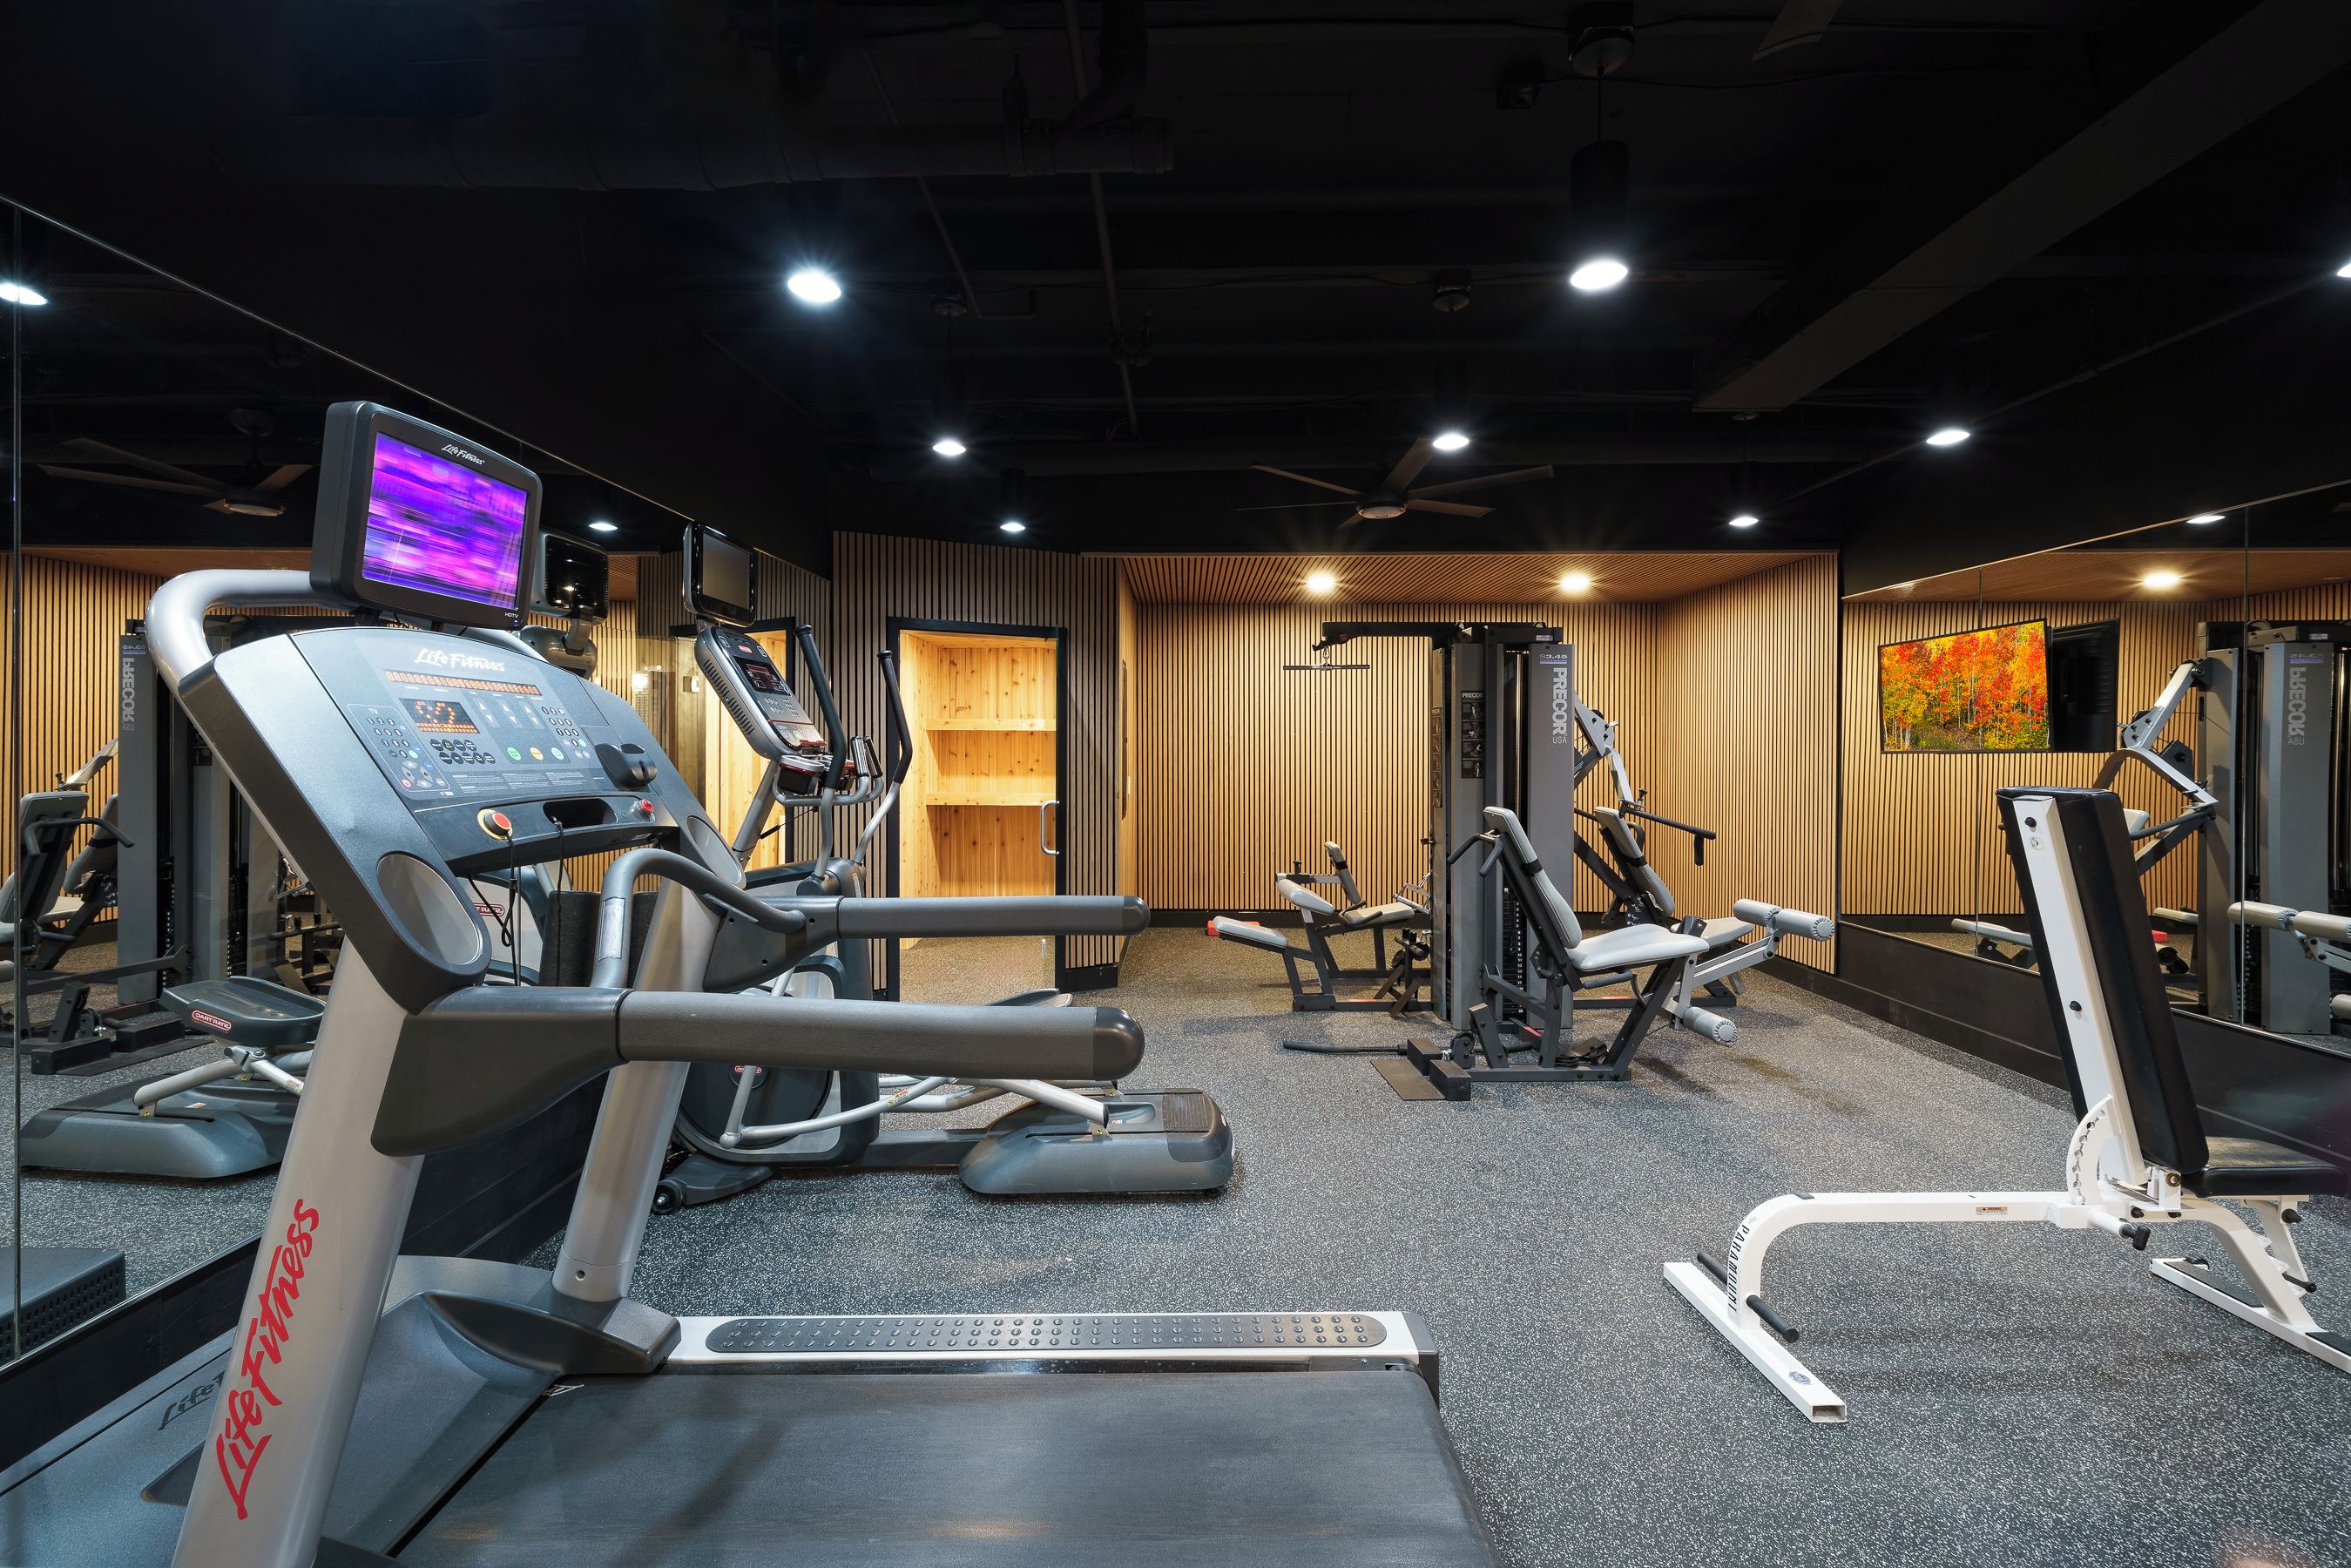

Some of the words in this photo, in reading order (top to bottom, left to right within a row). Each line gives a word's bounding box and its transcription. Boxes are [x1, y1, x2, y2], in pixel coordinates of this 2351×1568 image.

[415, 647, 449, 667] Life
[450, 653, 505, 672] Fitness
[1553, 667, 1567, 734] PRECOR
[241, 1199, 320, 1406] Fitness
[217, 1389, 273, 1520] Life
